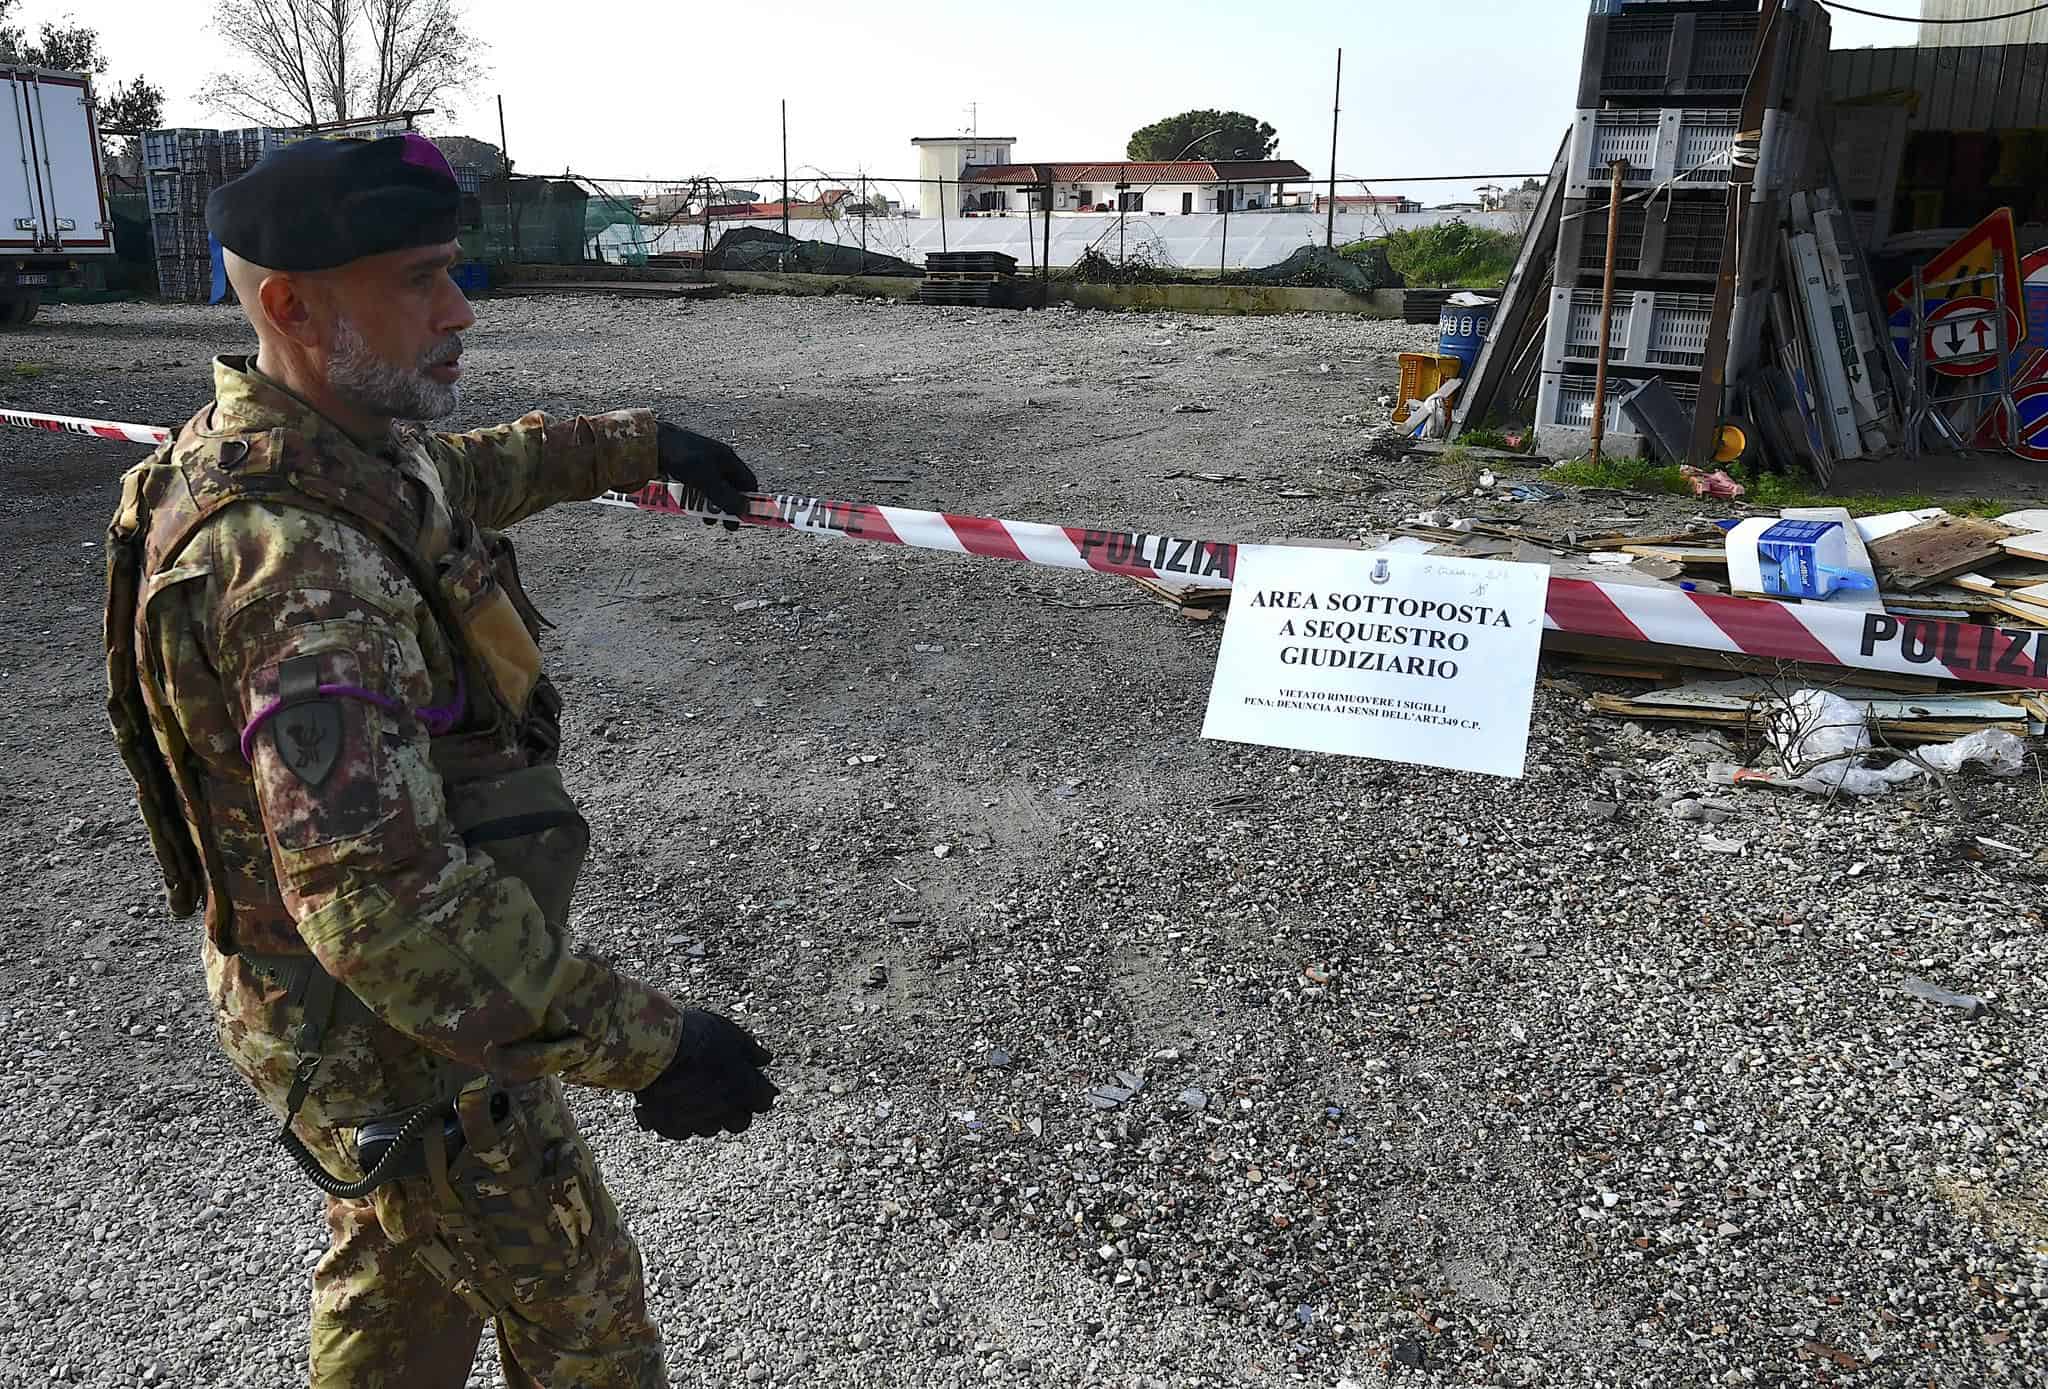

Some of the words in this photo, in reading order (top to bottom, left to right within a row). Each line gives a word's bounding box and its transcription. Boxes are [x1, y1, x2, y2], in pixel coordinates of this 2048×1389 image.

[1080, 529, 1230, 579] POLIZIA
[1250, 590, 1319, 609] AREA
[1326, 593, 1512, 628] SOTTOPOSTA
[1280, 619, 1296, 636] A
[1303, 619, 1469, 652] SEQUESTRO
[1280, 646, 1459, 680] GIUDIZIARIO
[1244, 696, 1274, 707] PENA:
[1277, 699, 1331, 712] DENUNCIA
[1333, 705, 1345, 713] AI
[1347, 706, 1379, 718] SENSI
[1460, 719, 1481, 730] C.P.
[1279, 688, 1326, 701] VIETATO
[1327, 692, 1395, 708] RIMUOVERE
[1397, 699, 1402, 708] I
[1403, 700, 1447, 714] SIGILLI
